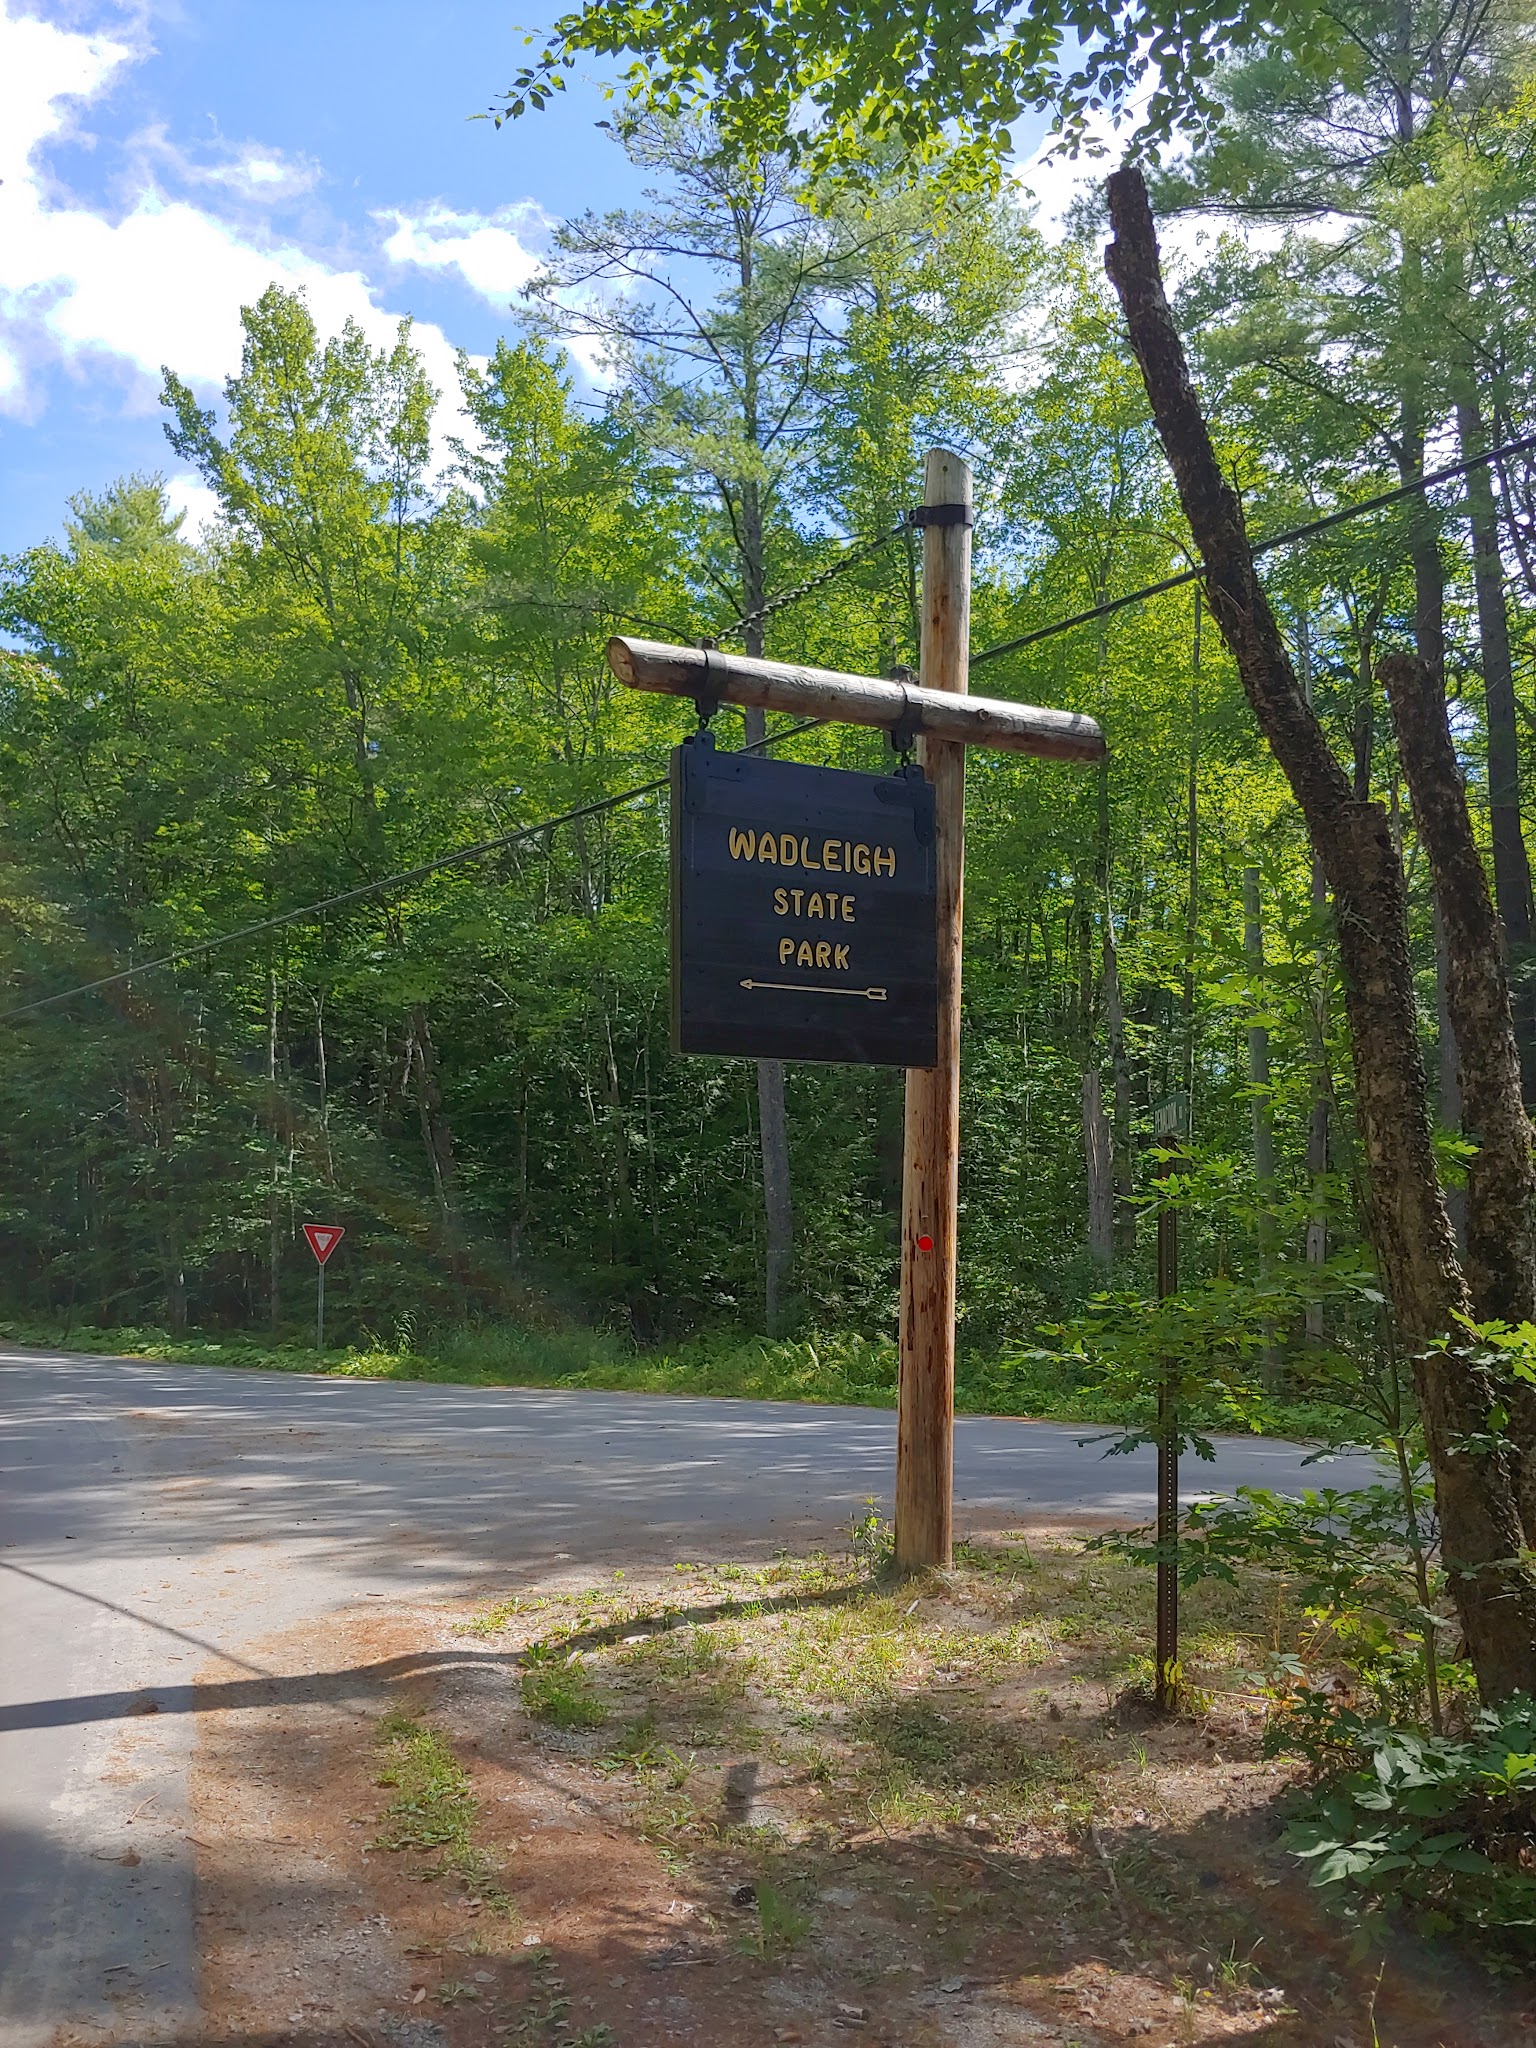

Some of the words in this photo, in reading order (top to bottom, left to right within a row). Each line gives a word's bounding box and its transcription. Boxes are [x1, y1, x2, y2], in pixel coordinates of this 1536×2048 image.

[729, 826, 896, 877] WADLEIGH
[773, 887, 856, 922] STATE
[778, 937, 850, 970] PARK
